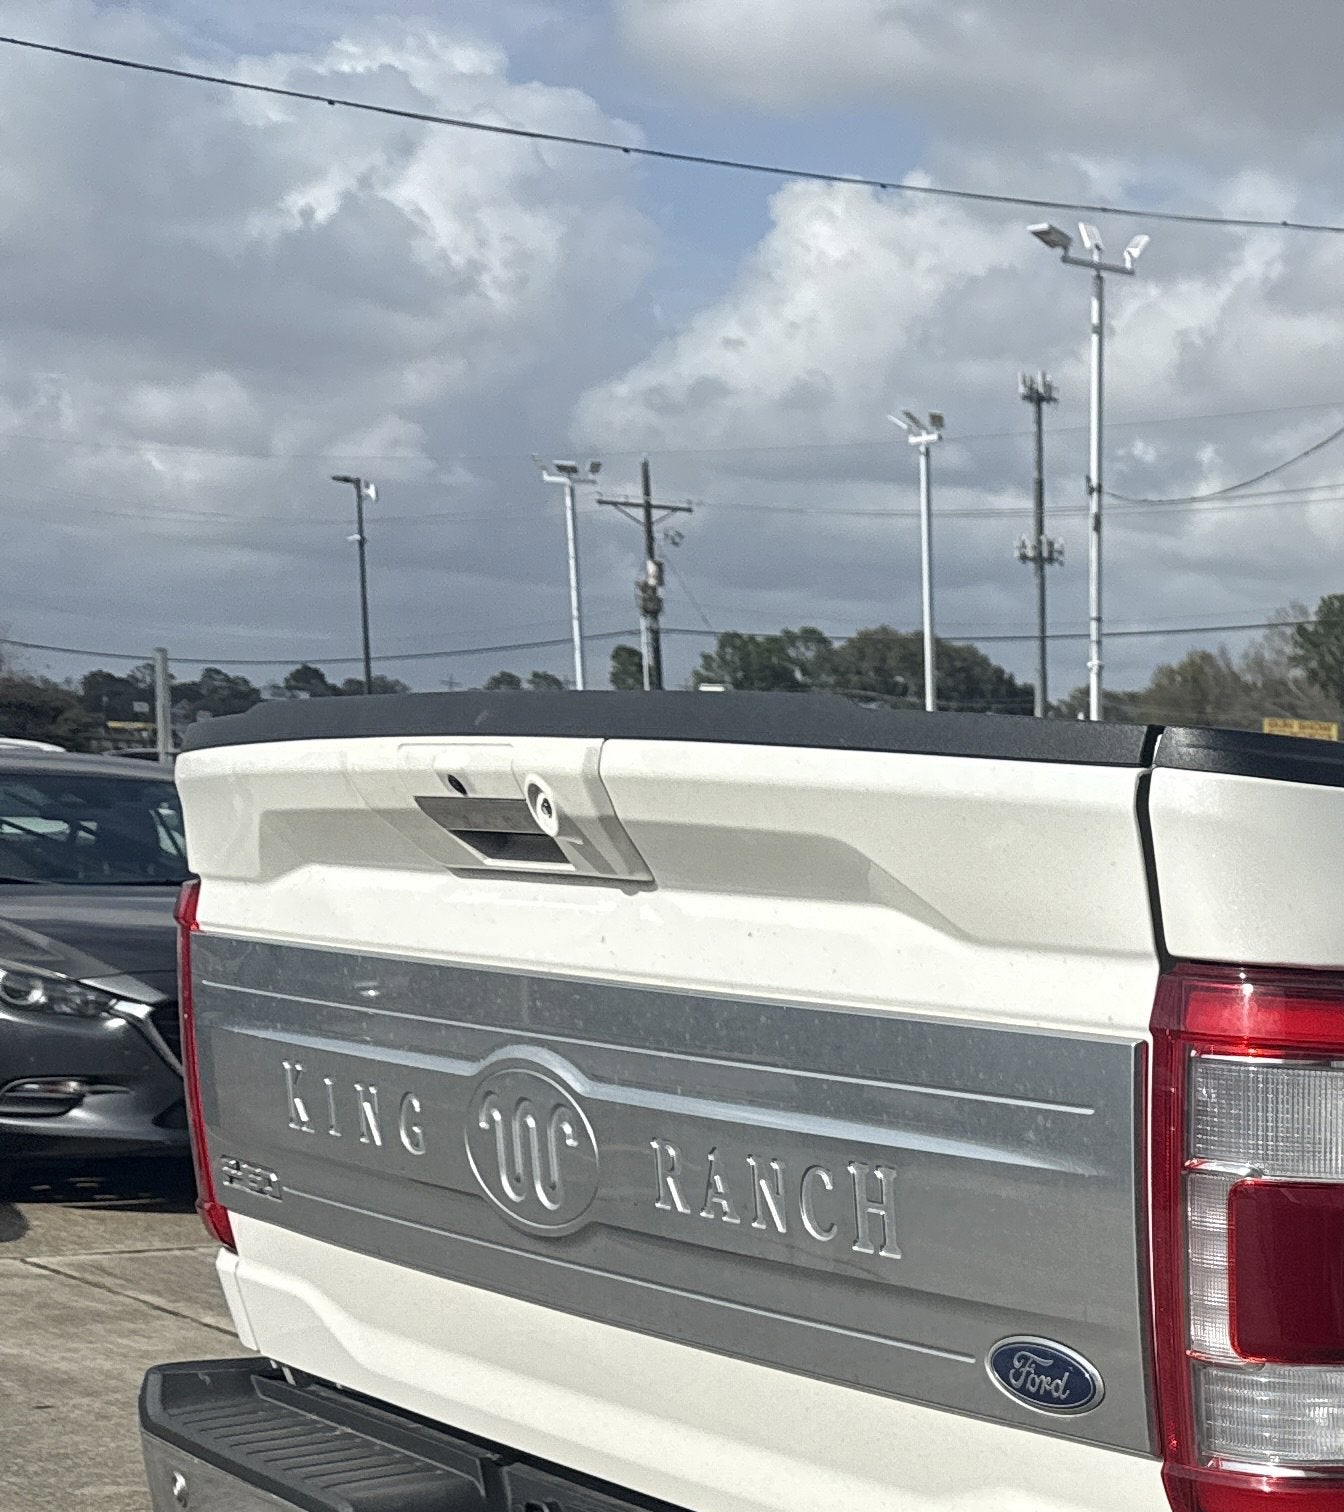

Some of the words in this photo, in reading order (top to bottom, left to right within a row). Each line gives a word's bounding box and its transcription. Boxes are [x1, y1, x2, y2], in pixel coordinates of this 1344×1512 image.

[282, 1060, 426, 1155] KING
[650, 1137, 902, 1260] RANCH
[1009, 1350, 1071, 1400] Ford
